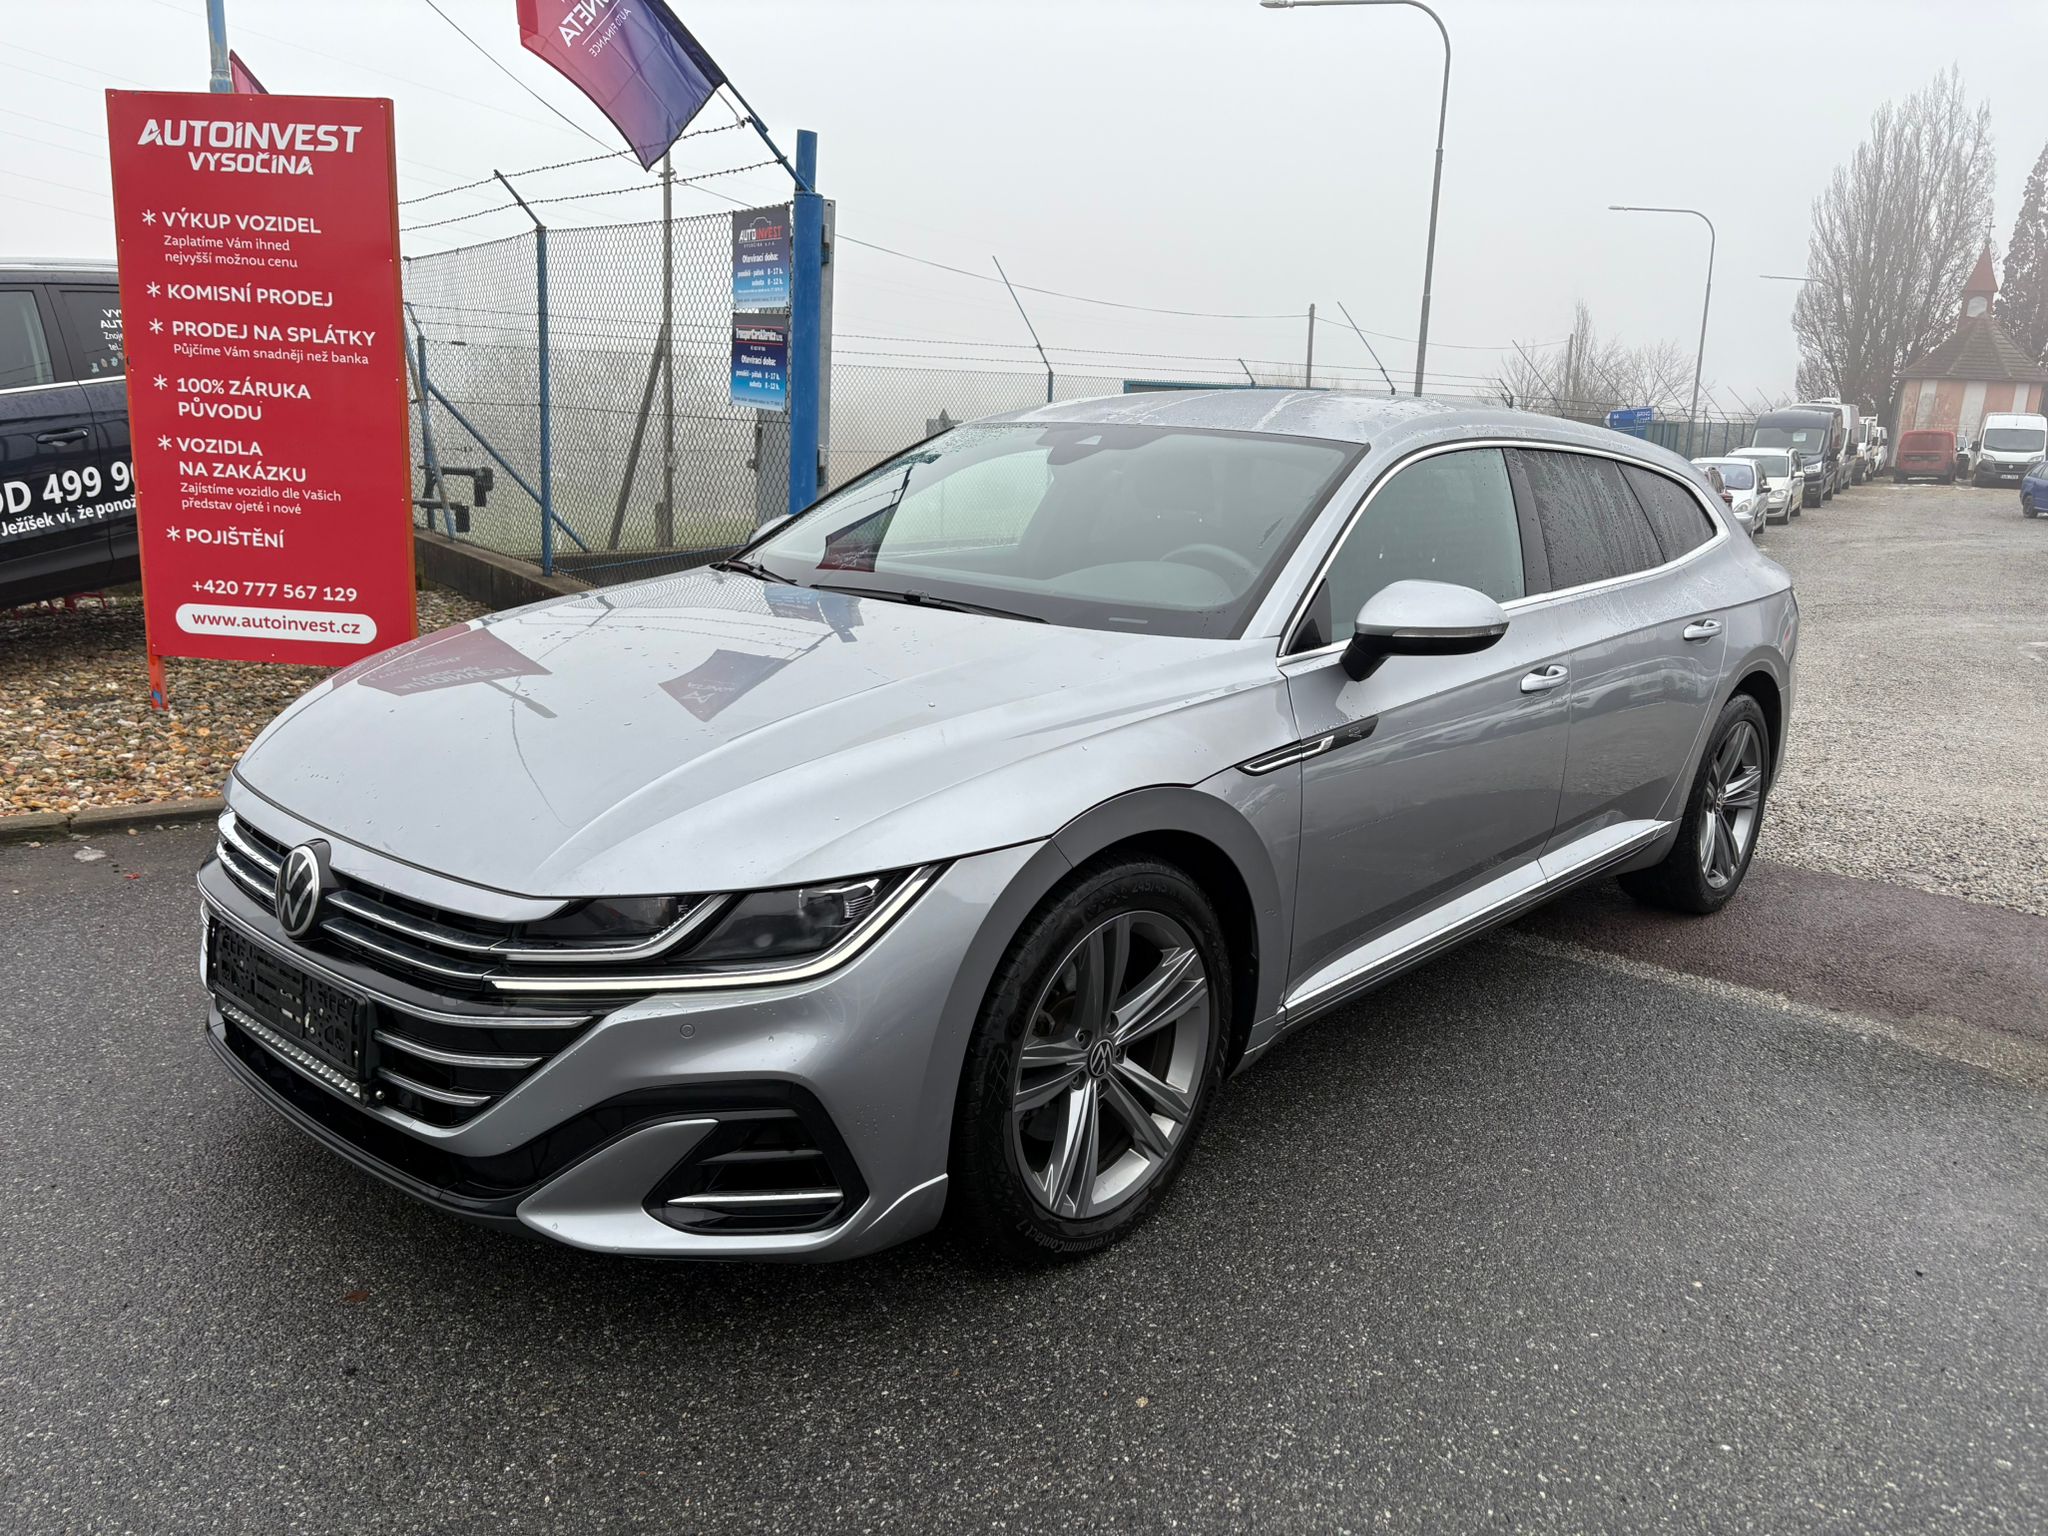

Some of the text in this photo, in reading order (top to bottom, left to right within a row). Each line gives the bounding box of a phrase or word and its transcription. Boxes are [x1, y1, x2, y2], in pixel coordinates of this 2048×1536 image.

[162, 207, 322, 234] VÝKUP VOZIDEL
[163, 234, 290, 251] Zaplatíme Vám ihned
[165, 251, 298, 268] nejvyšší možnou cenu
[167, 283, 333, 307] KOMISNÍ PRODEJ
[172, 320, 376, 347] PRODEJ NA SPLÁTKY
[173, 343, 369, 365] Půjčíme Vám snadněji než banka
[177, 377, 311, 399] 100% ZÁRUKA
[178, 397, 262, 421] PŮVODU
[176, 437, 263, 456] VOZIDLA
[179, 460, 307, 482] NA ZAKÁZKU
[0, 480, 32, 515] D
[42, 466, 102, 504] 499
[180, 482, 342, 502] Zajístíme vozidlo dle Vašich
[182, 497, 302, 514] představ ojeté i nové
[1, 512, 55, 537] Ježíšek
[56, 507, 75, 523] ví,
[77, 504, 95, 520] že
[185, 525, 285, 549] POJIŠTĚNÍ
[192, 579, 358, 602] +420 777 567 129
[192, 613, 361, 635] www.autoinvest.cz
